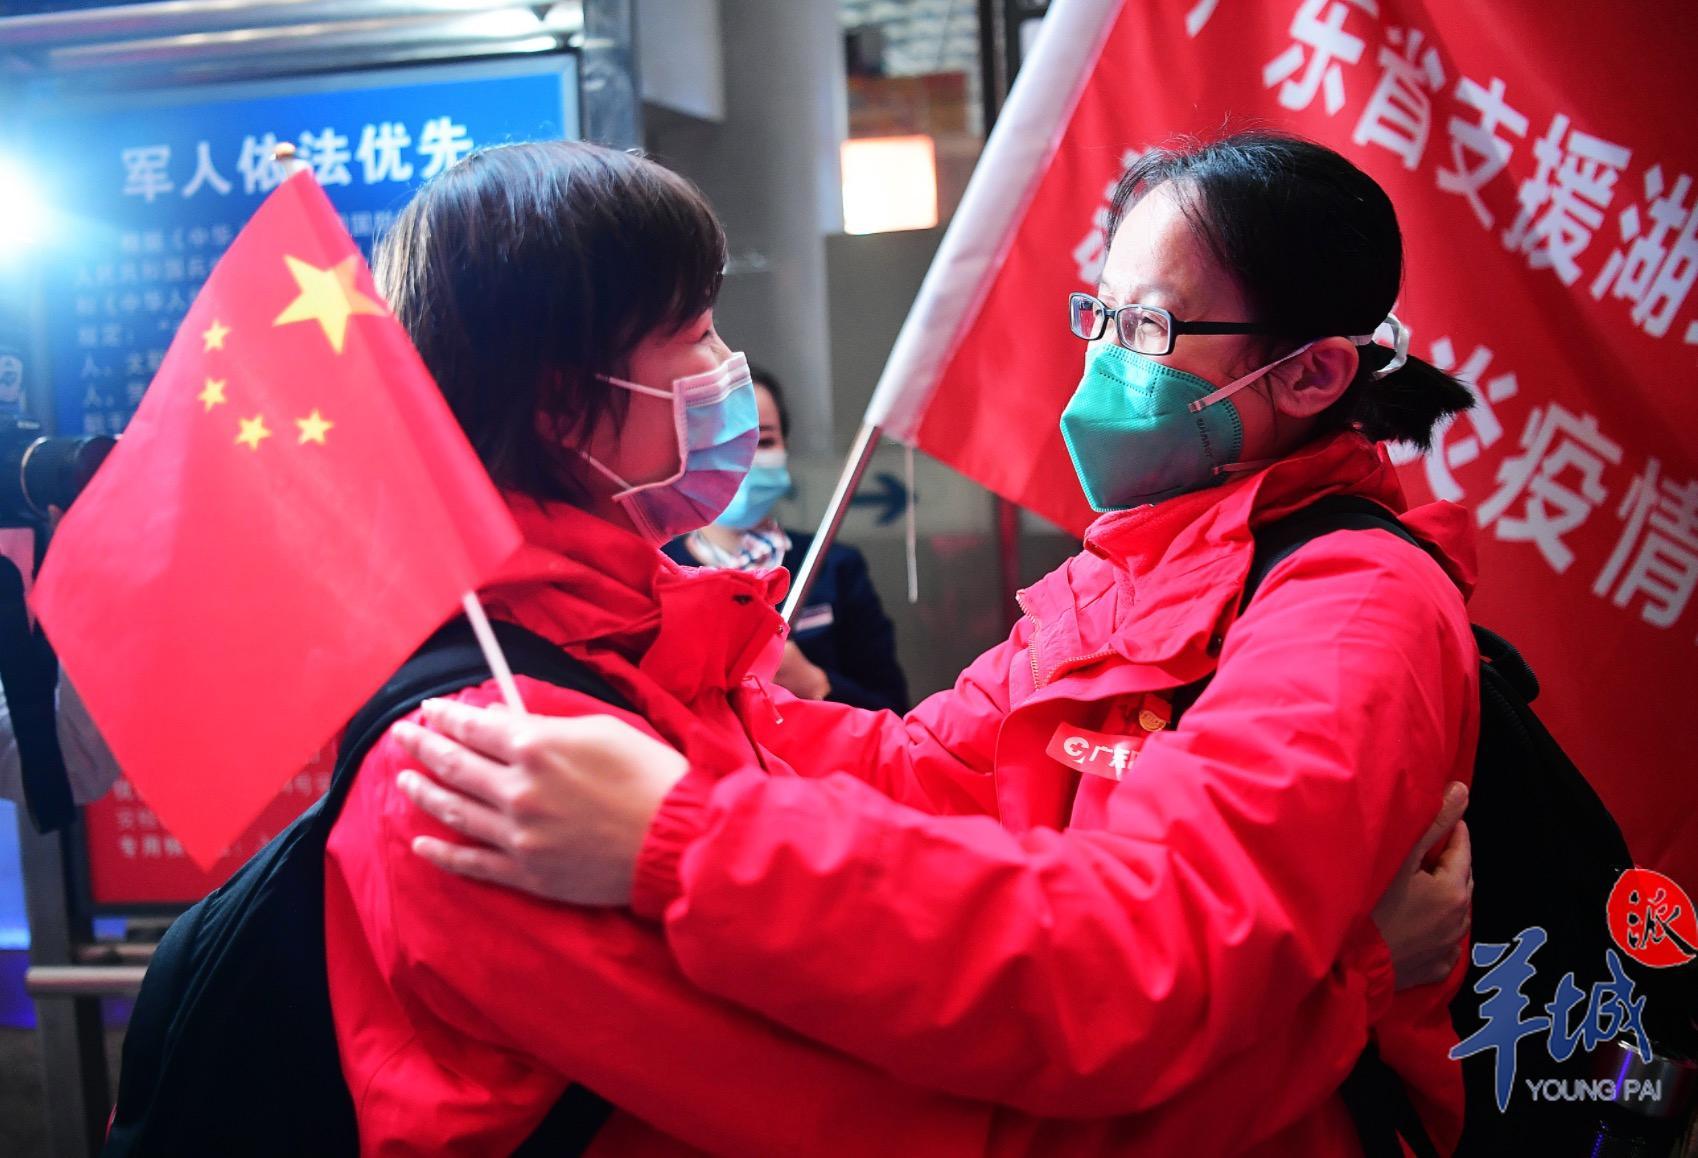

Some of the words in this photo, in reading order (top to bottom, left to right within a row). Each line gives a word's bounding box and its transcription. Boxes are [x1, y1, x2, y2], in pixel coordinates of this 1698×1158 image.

[1188, 0, 1698, 345] 东省支援湖
